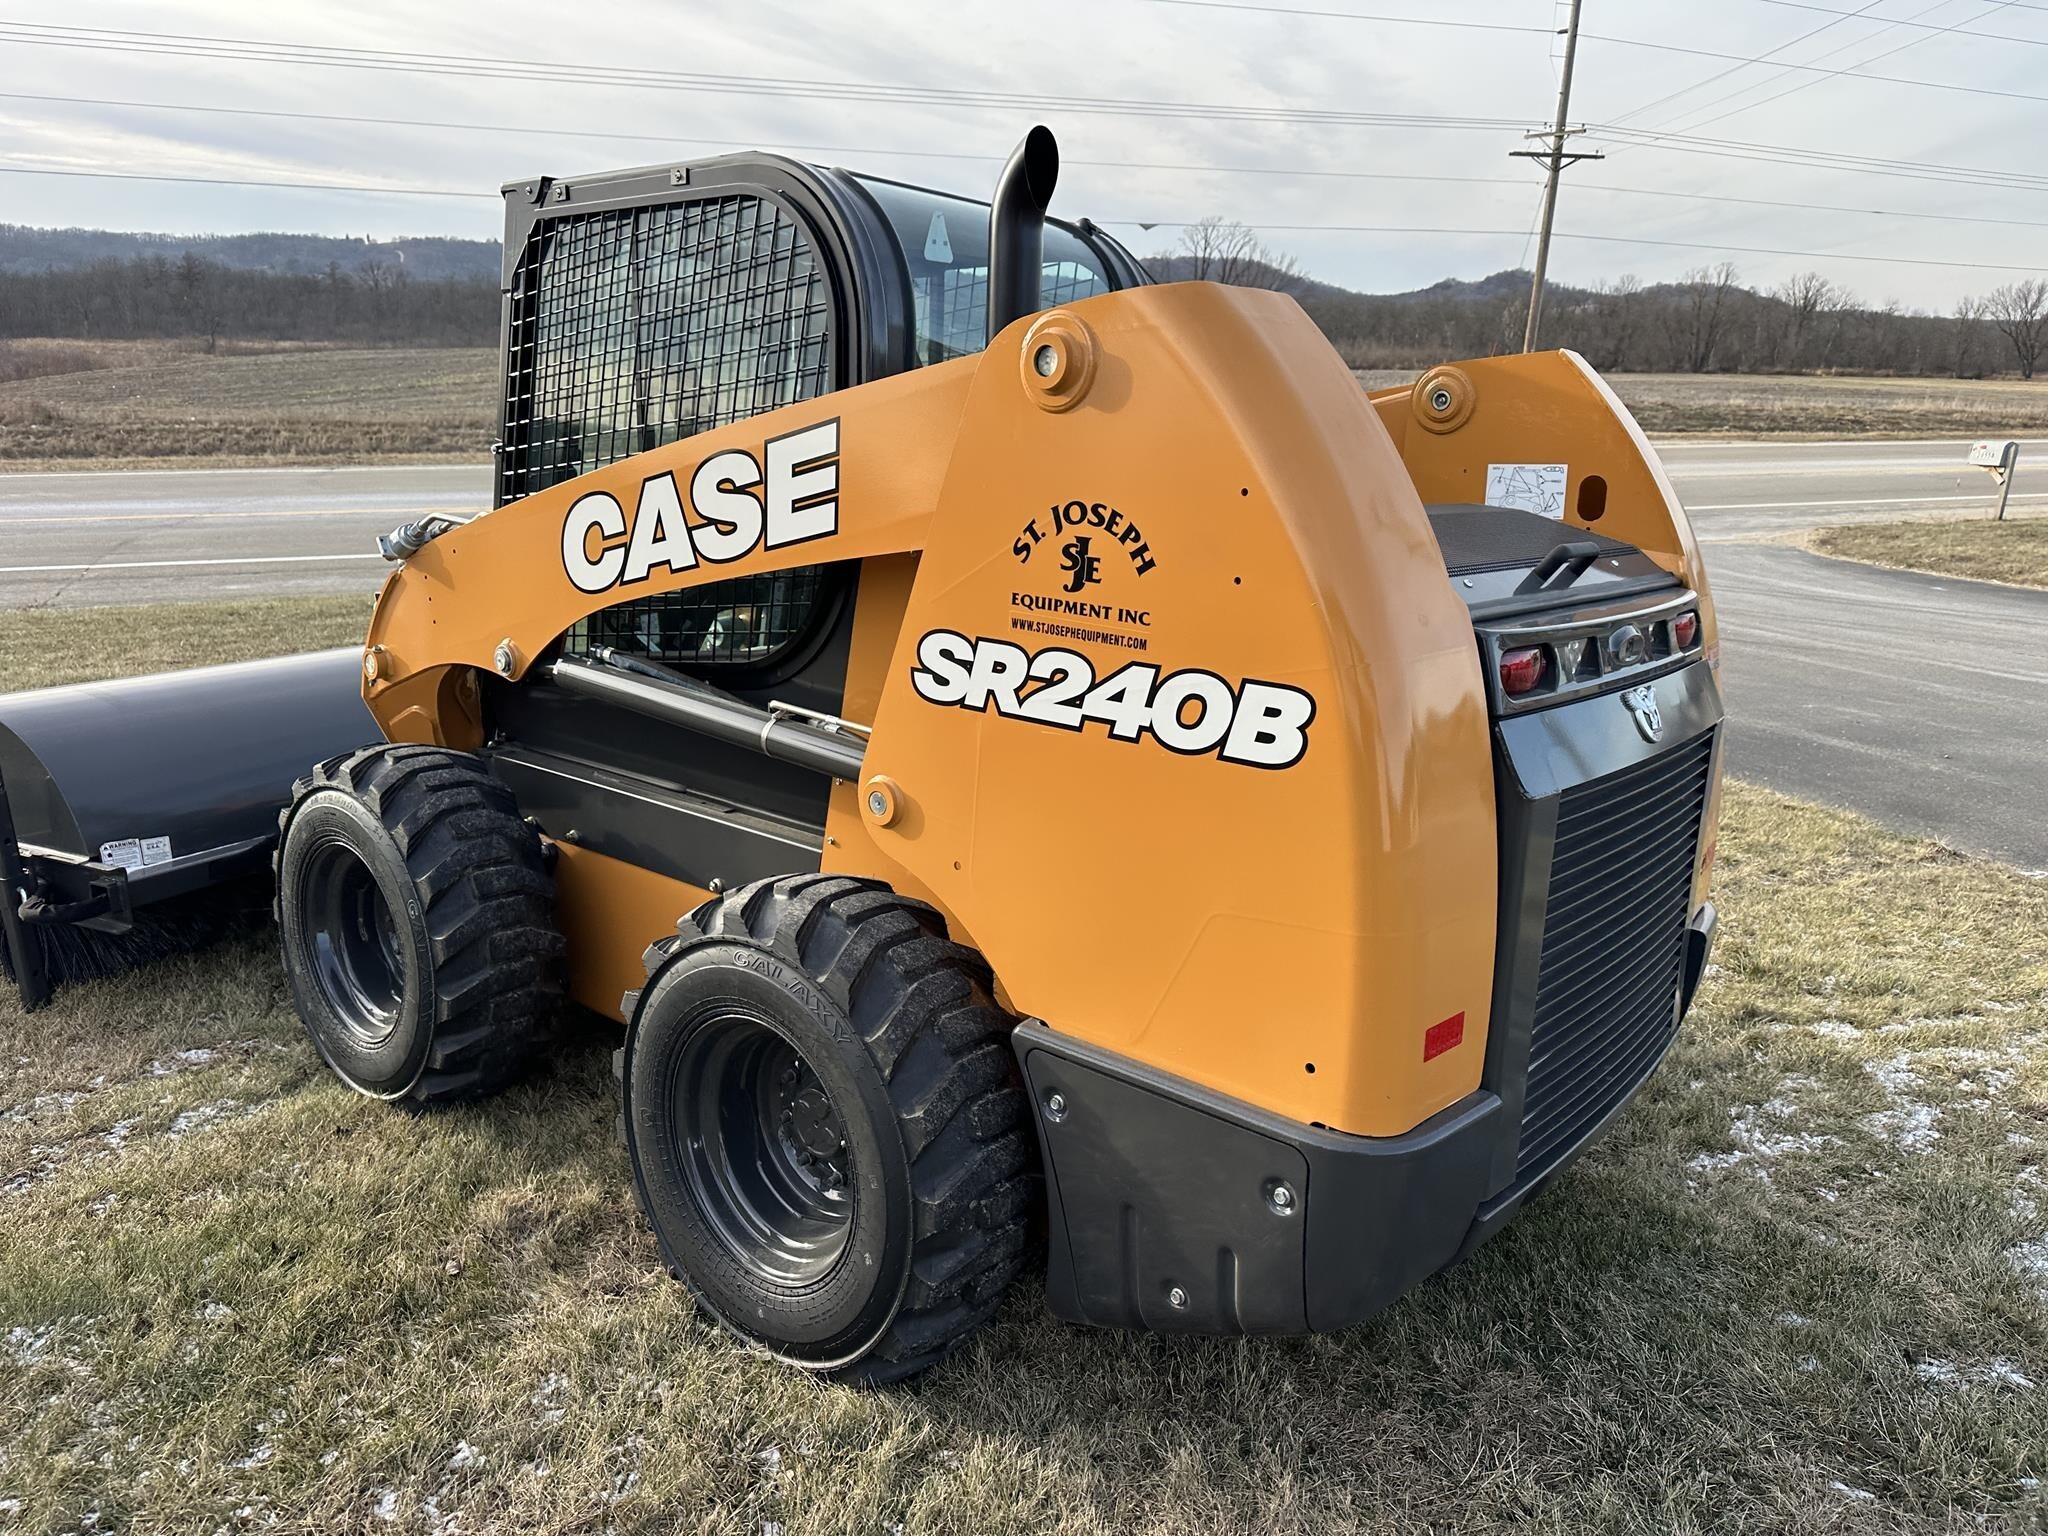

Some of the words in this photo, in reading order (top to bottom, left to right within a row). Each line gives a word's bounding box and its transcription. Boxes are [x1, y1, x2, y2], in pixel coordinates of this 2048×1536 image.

[561, 416, 840, 594] CASE
[1013, 518, 1047, 564] ST.
[1050, 500, 1157, 577] JOSEPH
[1011, 592, 1112, 620] EQUIPMENT
[1117, 608, 1152, 626] INC
[1011, 617, 1148, 651] WWW.STJOSEPHEQUIPMENT.COM
[911, 628, 1317, 770] SR240B
[109, 839, 137, 850] WARNING
[732, 949, 854, 1044] GALAXY
